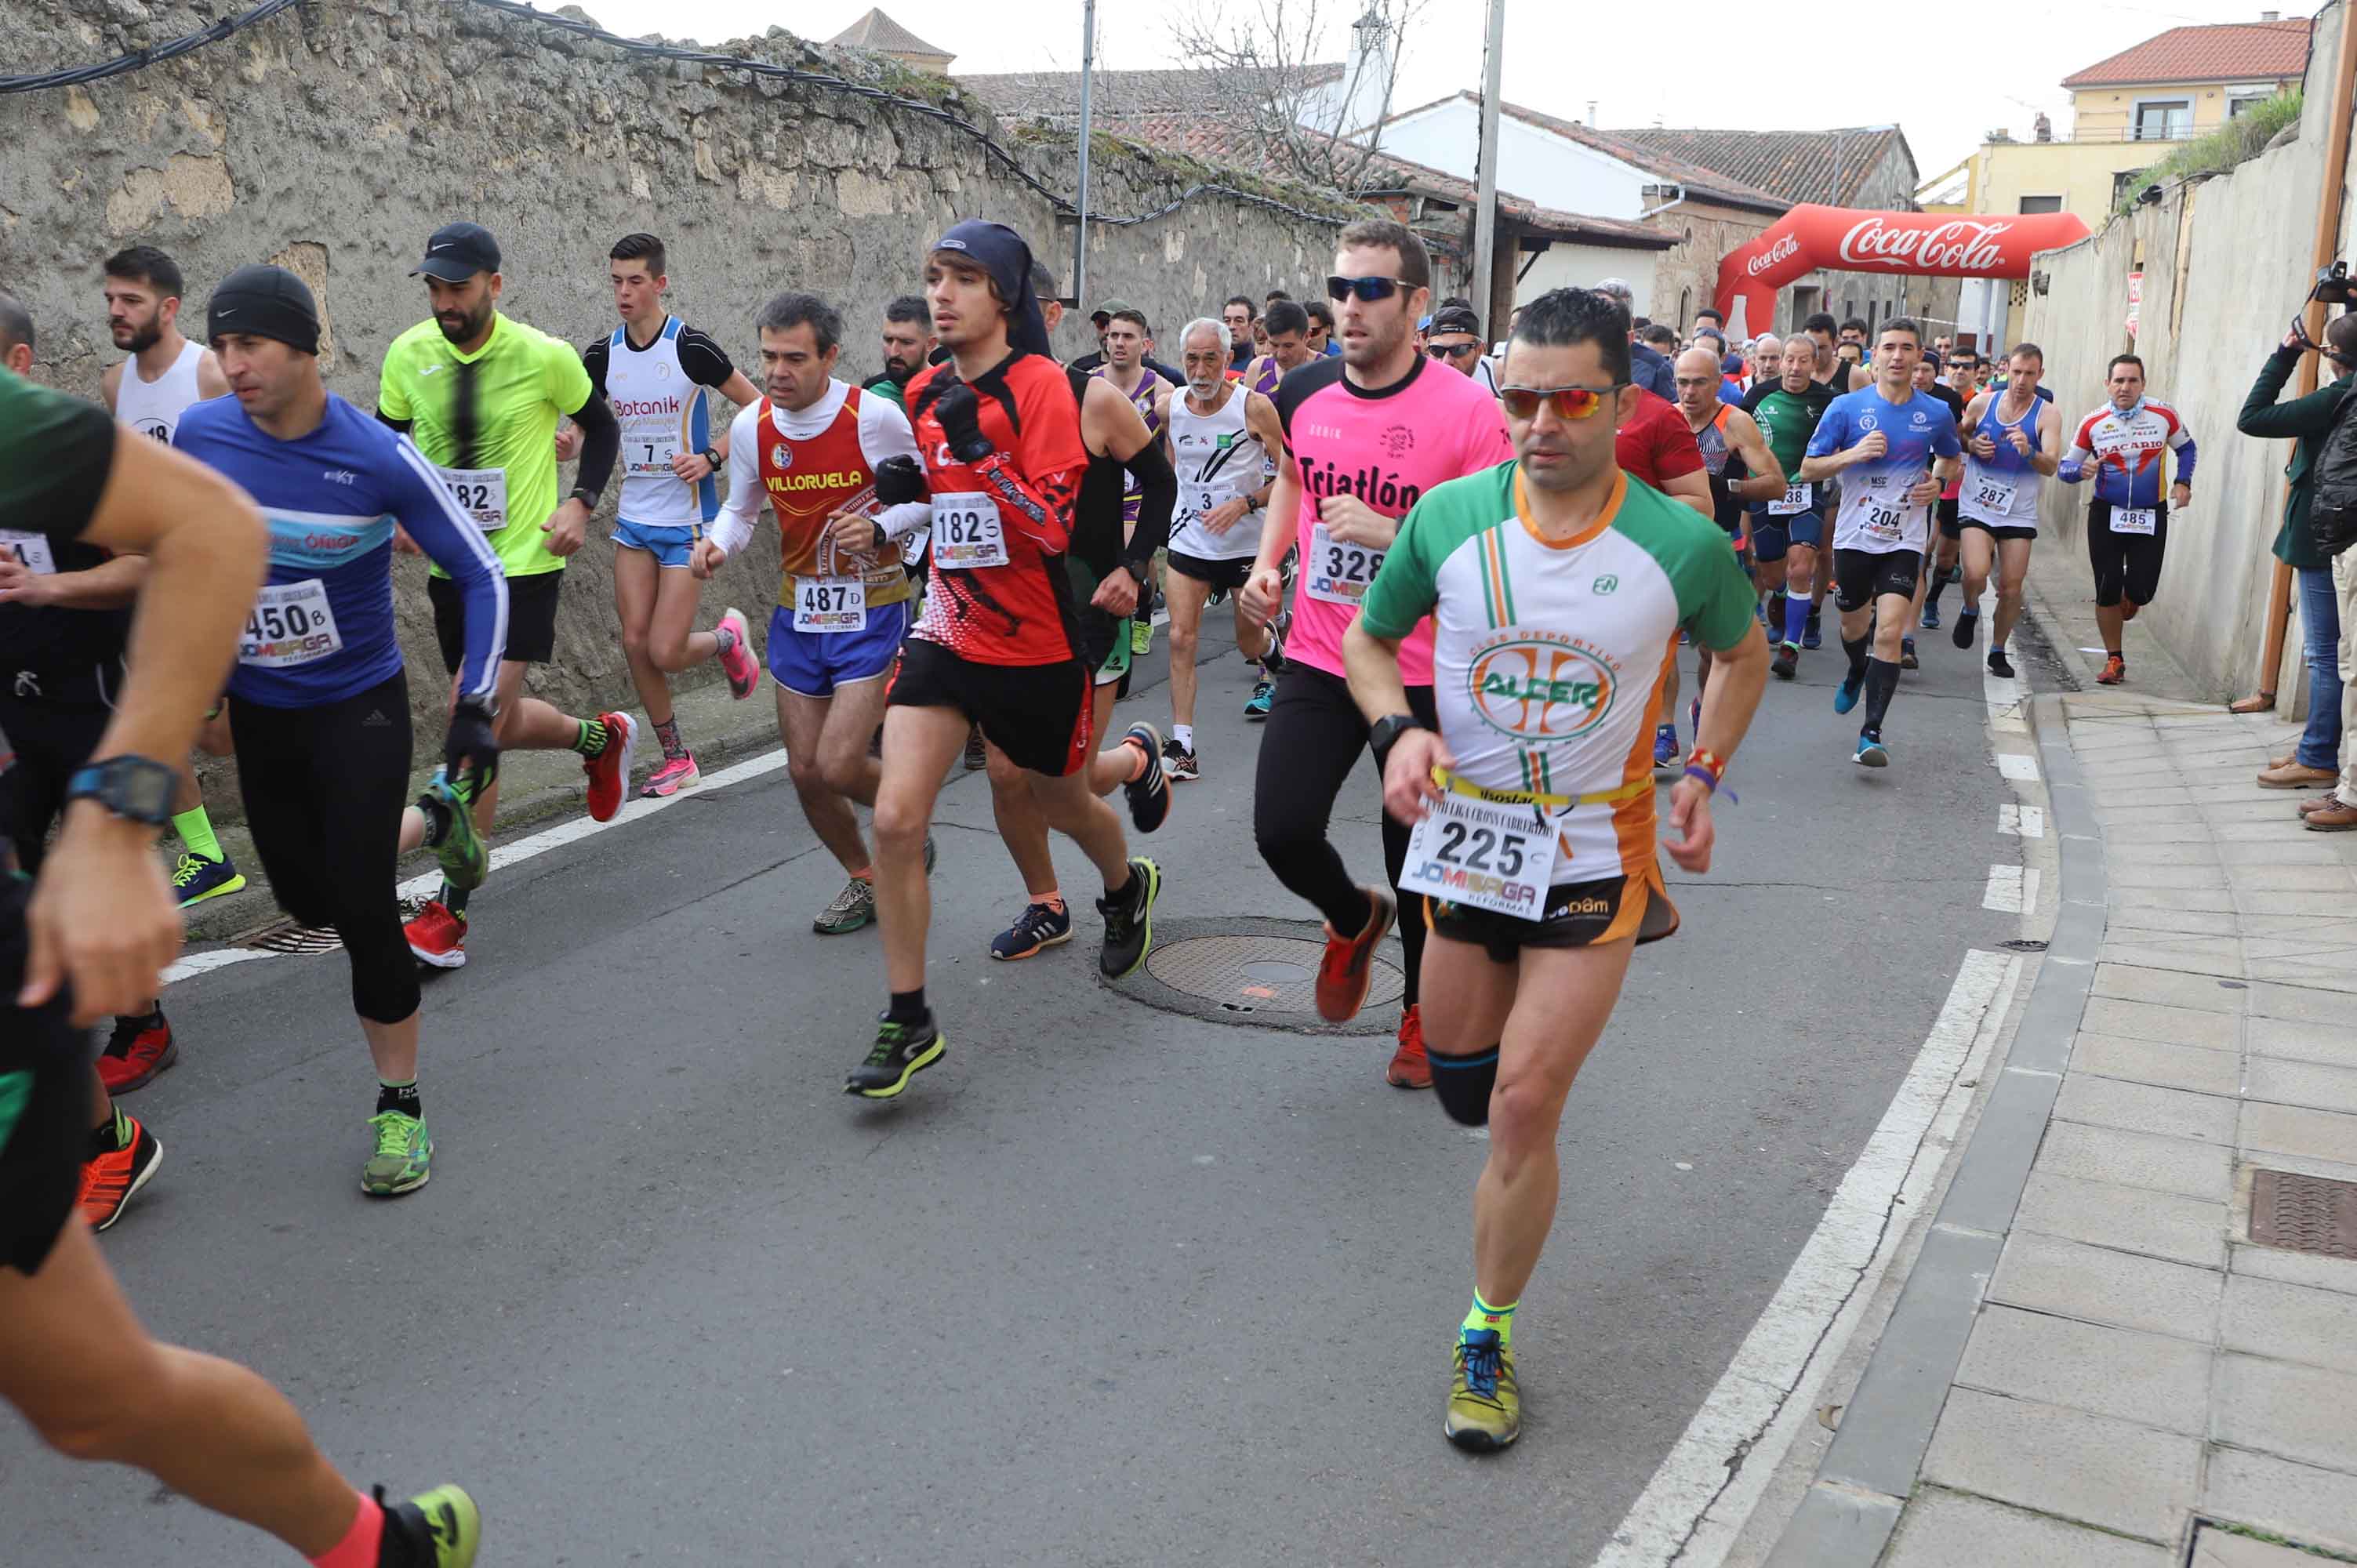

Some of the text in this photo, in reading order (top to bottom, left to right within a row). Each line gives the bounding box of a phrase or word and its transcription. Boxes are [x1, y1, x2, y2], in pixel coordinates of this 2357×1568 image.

[1839, 217, 2014, 270] Coca-Cola
[614, 395, 680, 416] Botanik
[644, 445, 654, 462] 7
[2099, 441, 2163, 454] MACARIO
[765, 470, 863, 492] VILLORUELA
[1299, 457, 1420, 509] Triatlón
[446, 483, 488, 510] 82
[1201, 493, 1212, 510] 3
[1979, 487, 2006, 503] 287
[939, 512, 982, 543] 182
[1870, 508, 1901, 528] 204
[2120, 513, 2146, 524] 485
[1326, 547, 1386, 583] 328
[805, 587, 847, 611] 487
[245, 605, 310, 641] 450
[1520, 631, 1623, 671] DEPORTIVO
[1480, 672, 1601, 710] ALCER
[1436, 822, 1526, 877] 225
